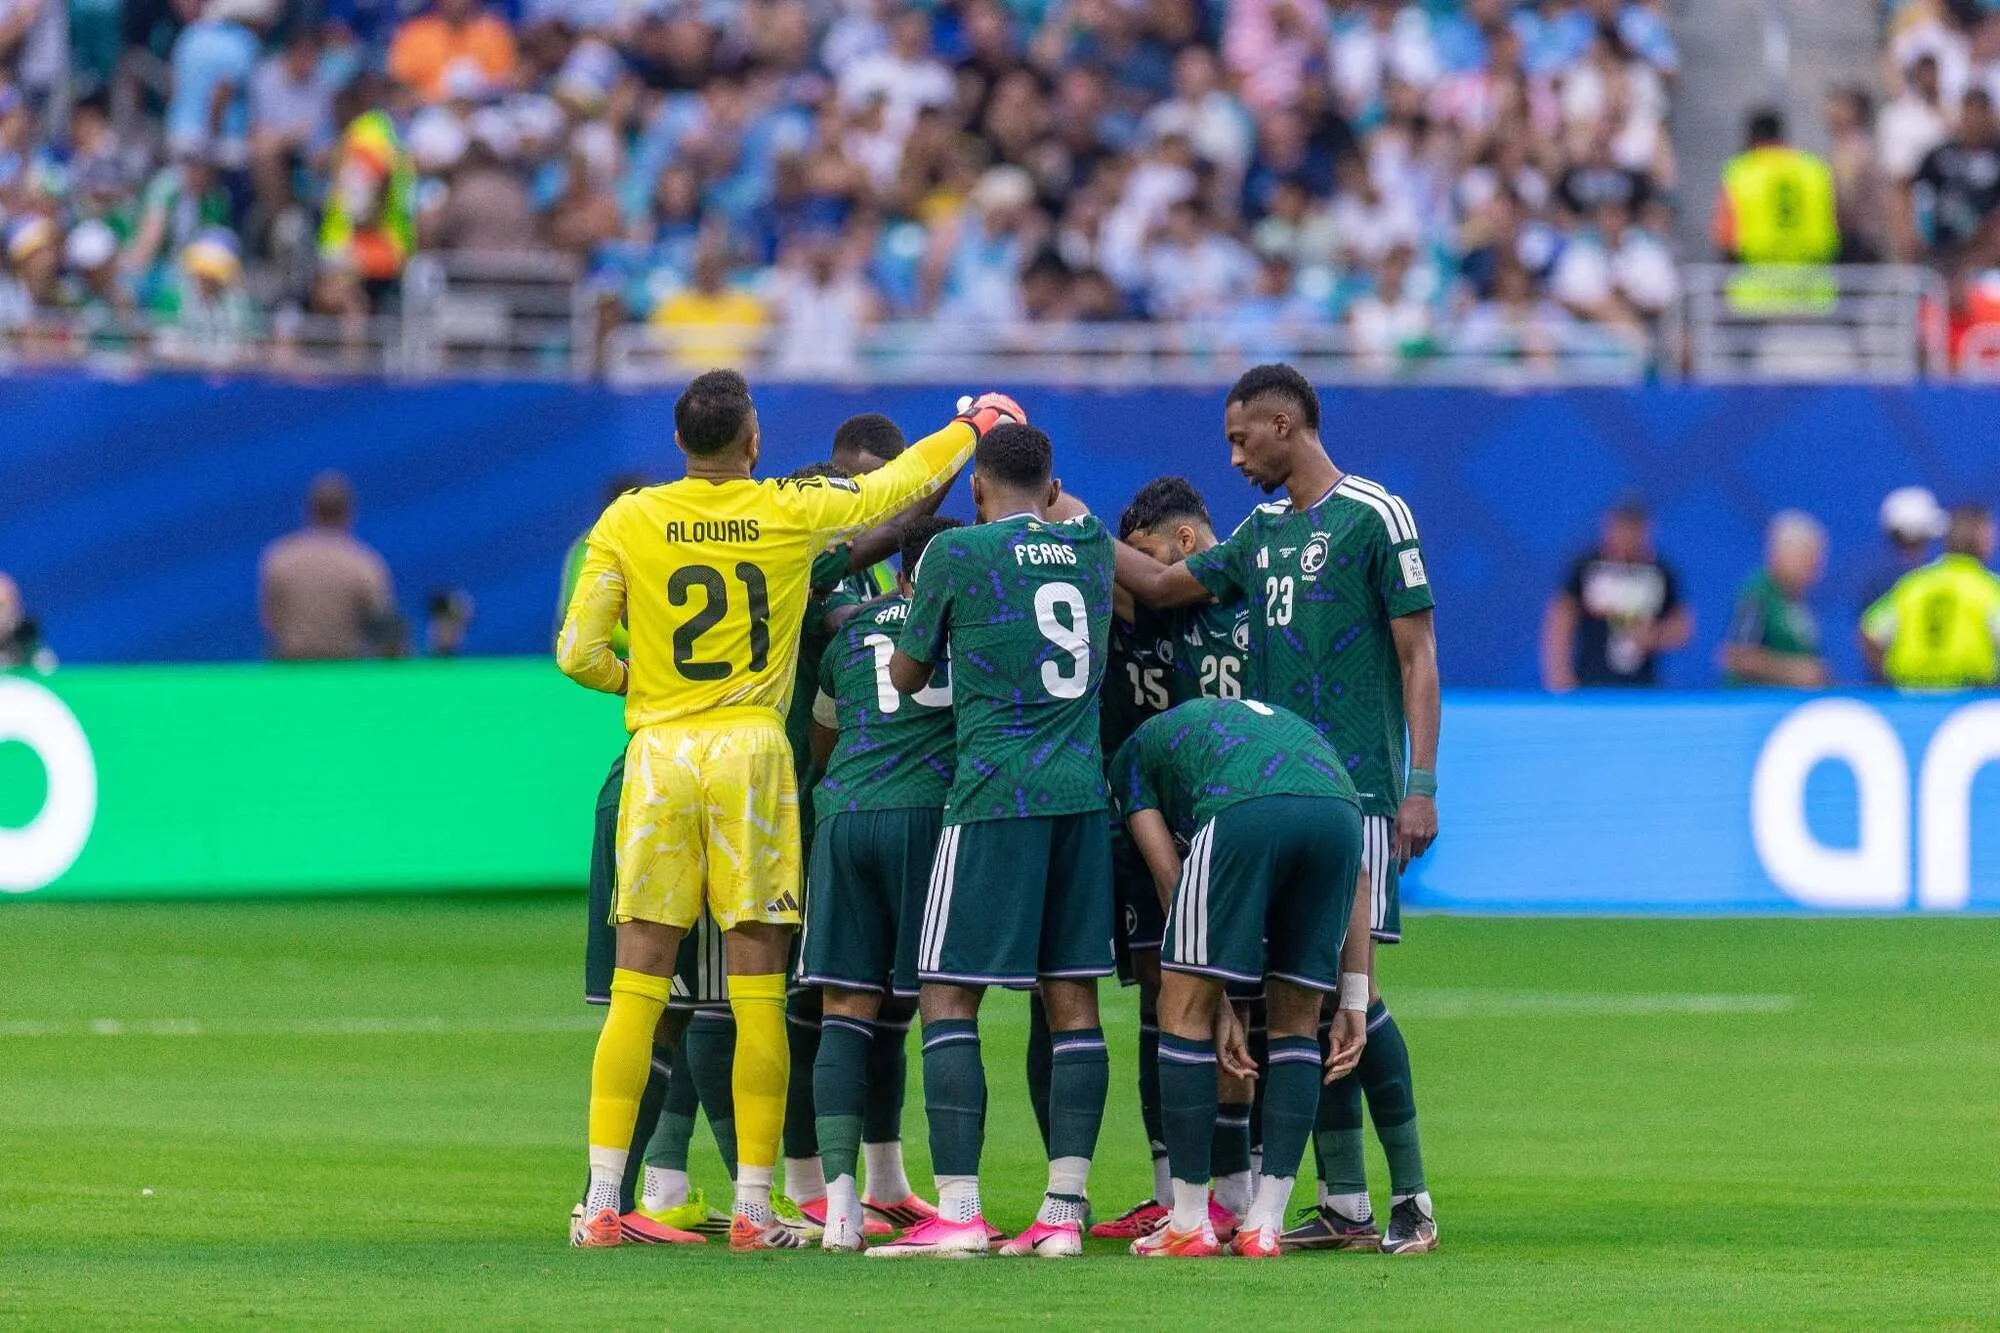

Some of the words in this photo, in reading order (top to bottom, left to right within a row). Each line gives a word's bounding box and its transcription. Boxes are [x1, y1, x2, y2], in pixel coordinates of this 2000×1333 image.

[667, 519, 760, 543] ALOWAIS
[1014, 543, 1077, 566] FERAS
[668, 561, 770, 681] 21
[1266, 576, 1293, 627] 23
[1034, 581, 1090, 699] 9
[1126, 662, 1169, 710] 15
[1200, 655, 1241, 699] 26
